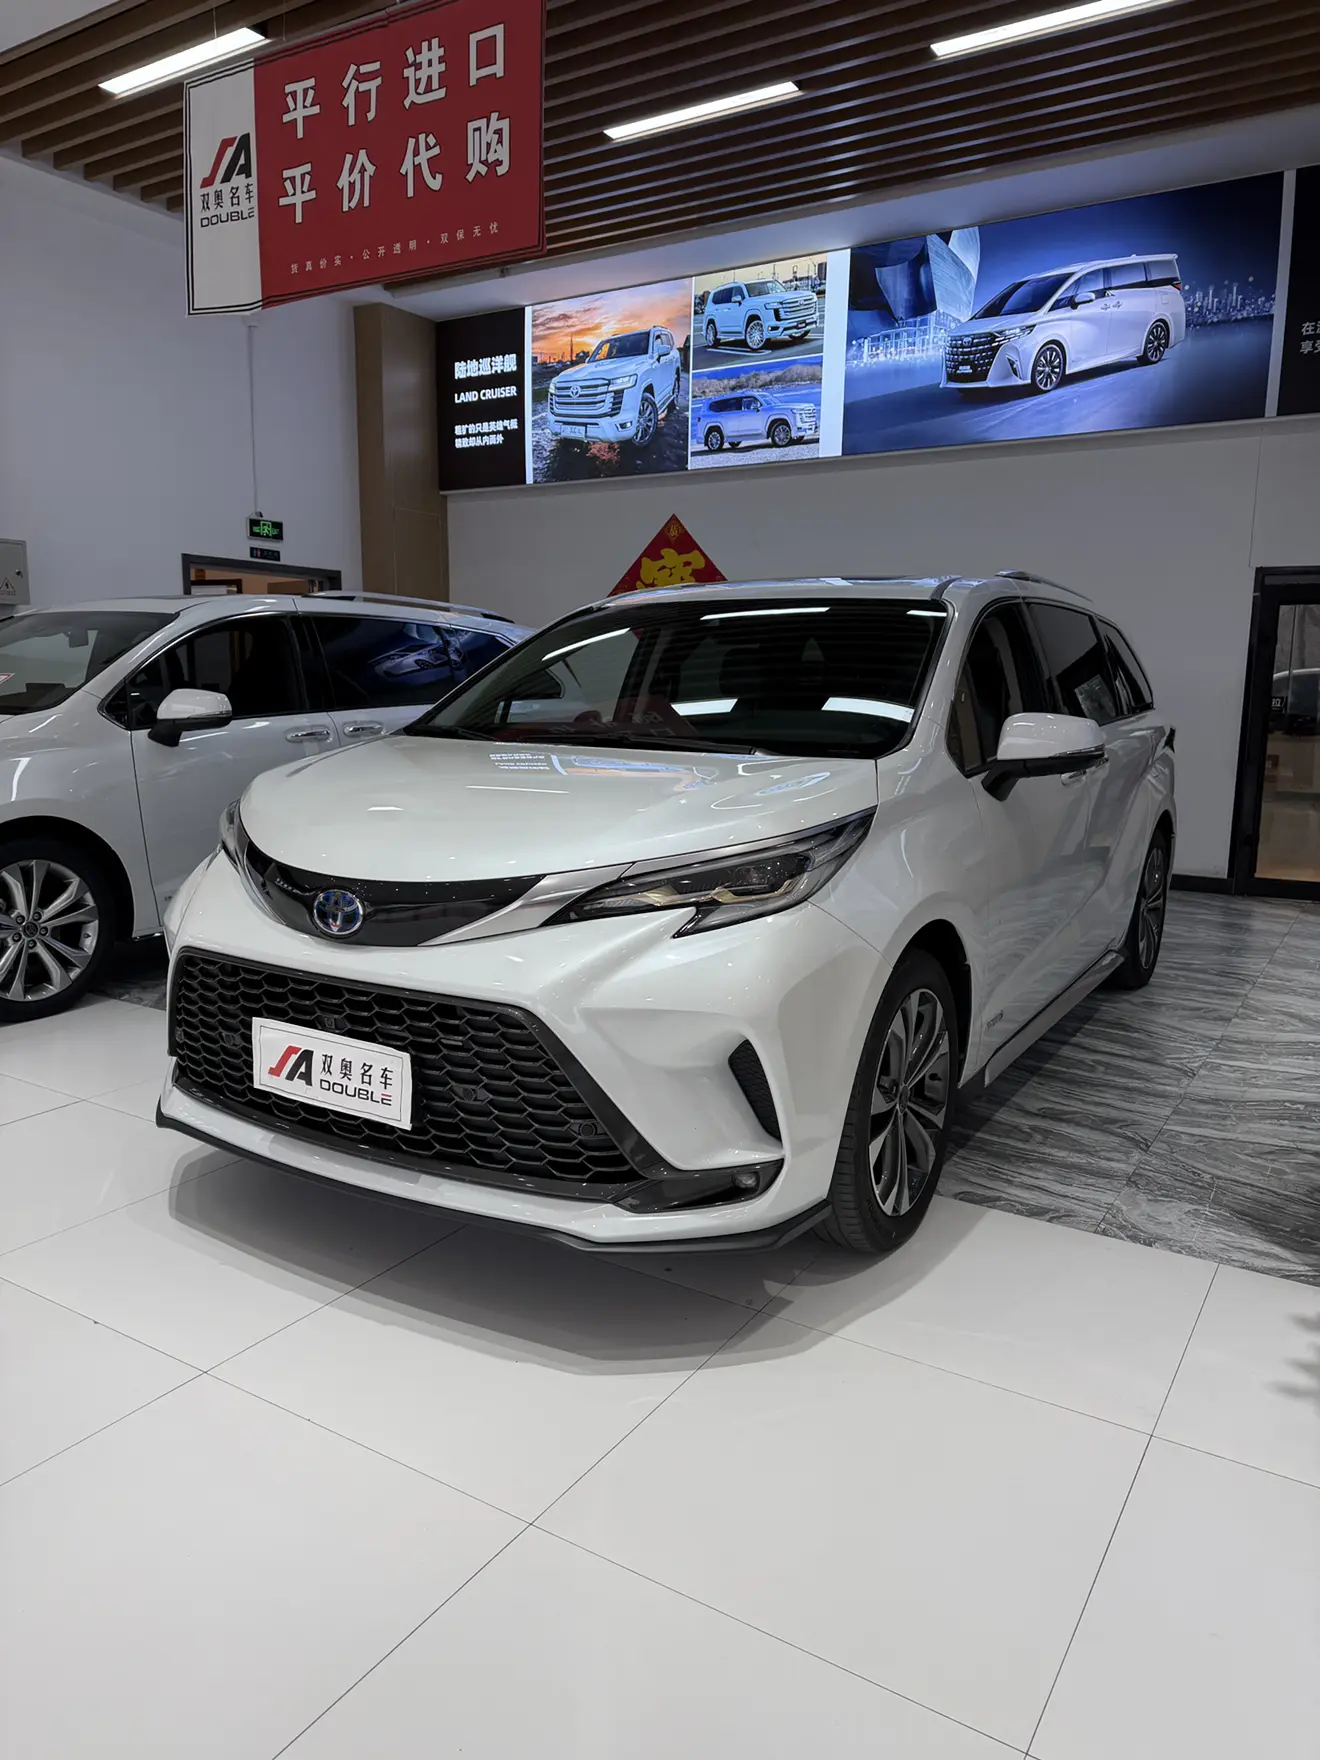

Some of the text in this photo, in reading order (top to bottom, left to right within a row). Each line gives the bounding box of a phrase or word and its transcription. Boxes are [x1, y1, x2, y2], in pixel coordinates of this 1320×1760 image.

[282, 23, 505, 139] 平行进口
[278, 112, 511, 224] 平价代购
[200, 183, 254, 212] 双奥名车
[200, 207, 255, 228] DOUBLE
[455, 354, 517, 379] 陆地巡洋舰
[455, 386, 517, 403] LAND CRUISER
[320, 1053, 393, 1090] 双奥名车
[319, 1078, 392, 1106] DOUBLE
